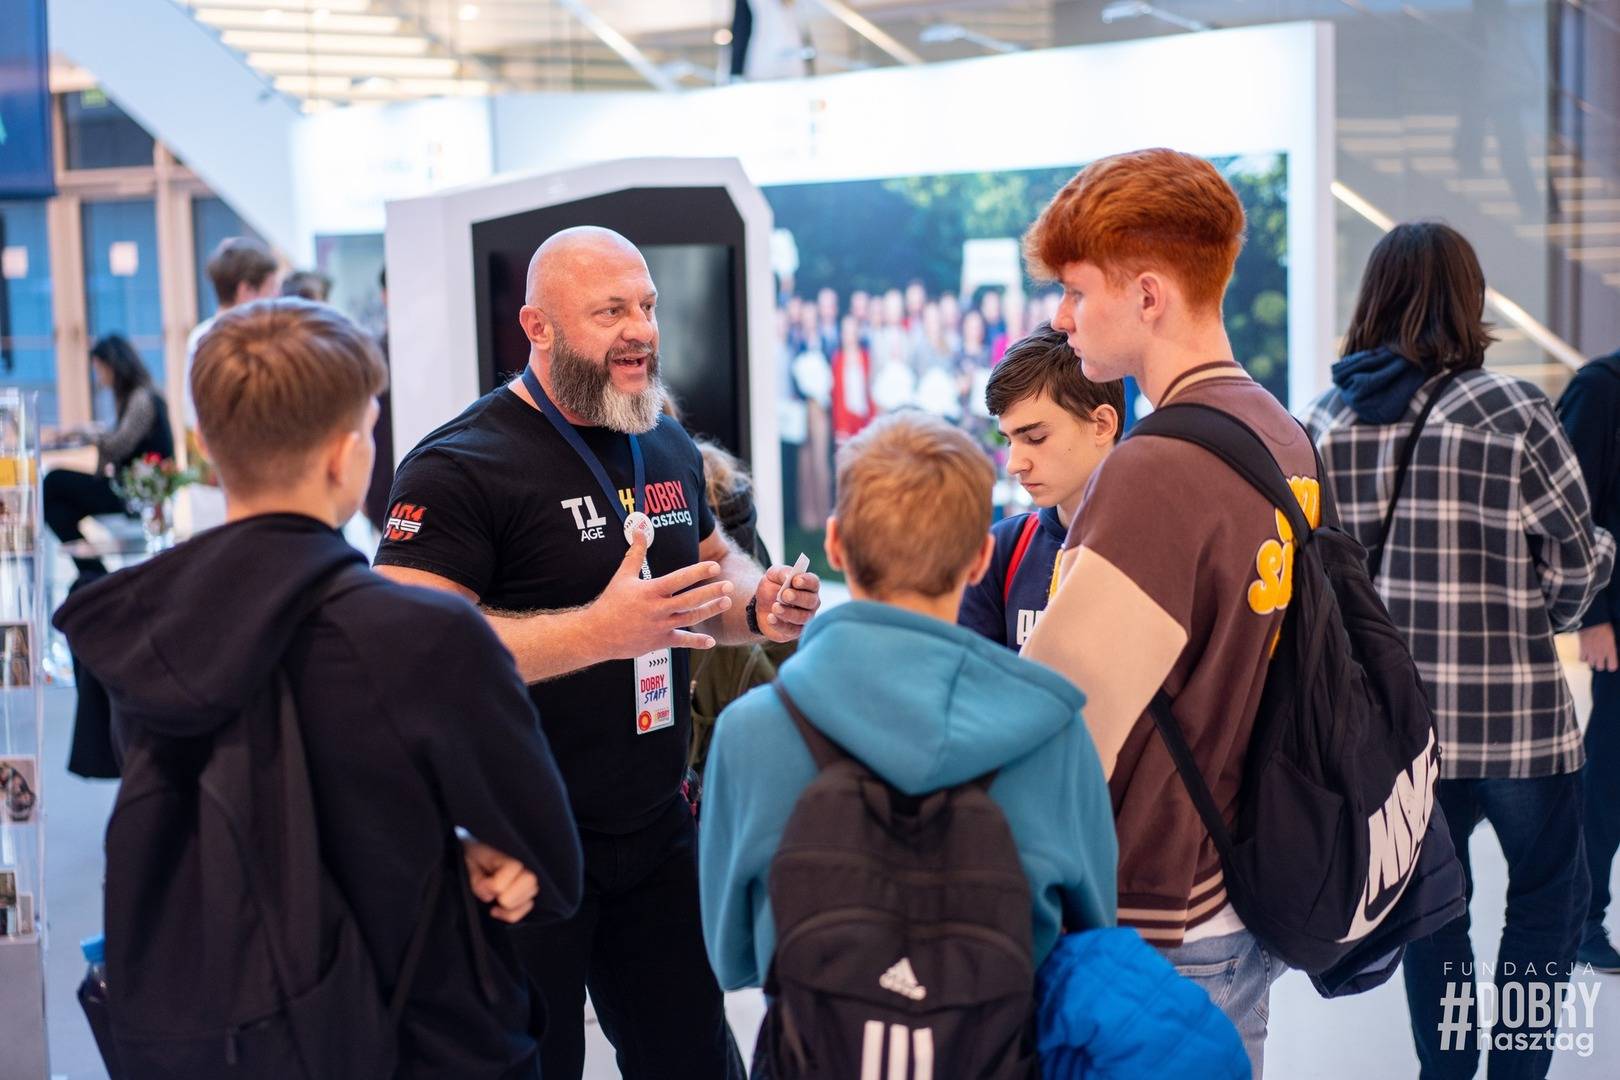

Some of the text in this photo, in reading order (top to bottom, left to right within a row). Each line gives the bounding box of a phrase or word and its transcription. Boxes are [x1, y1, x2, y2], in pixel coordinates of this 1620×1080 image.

[618, 480, 688, 515] #OBRY
[651, 510, 693, 529] asztag
[581, 527, 606, 542] AGE
[640, 674, 665, 693] DOBRY
[644, 687, 669, 704] STAFF
